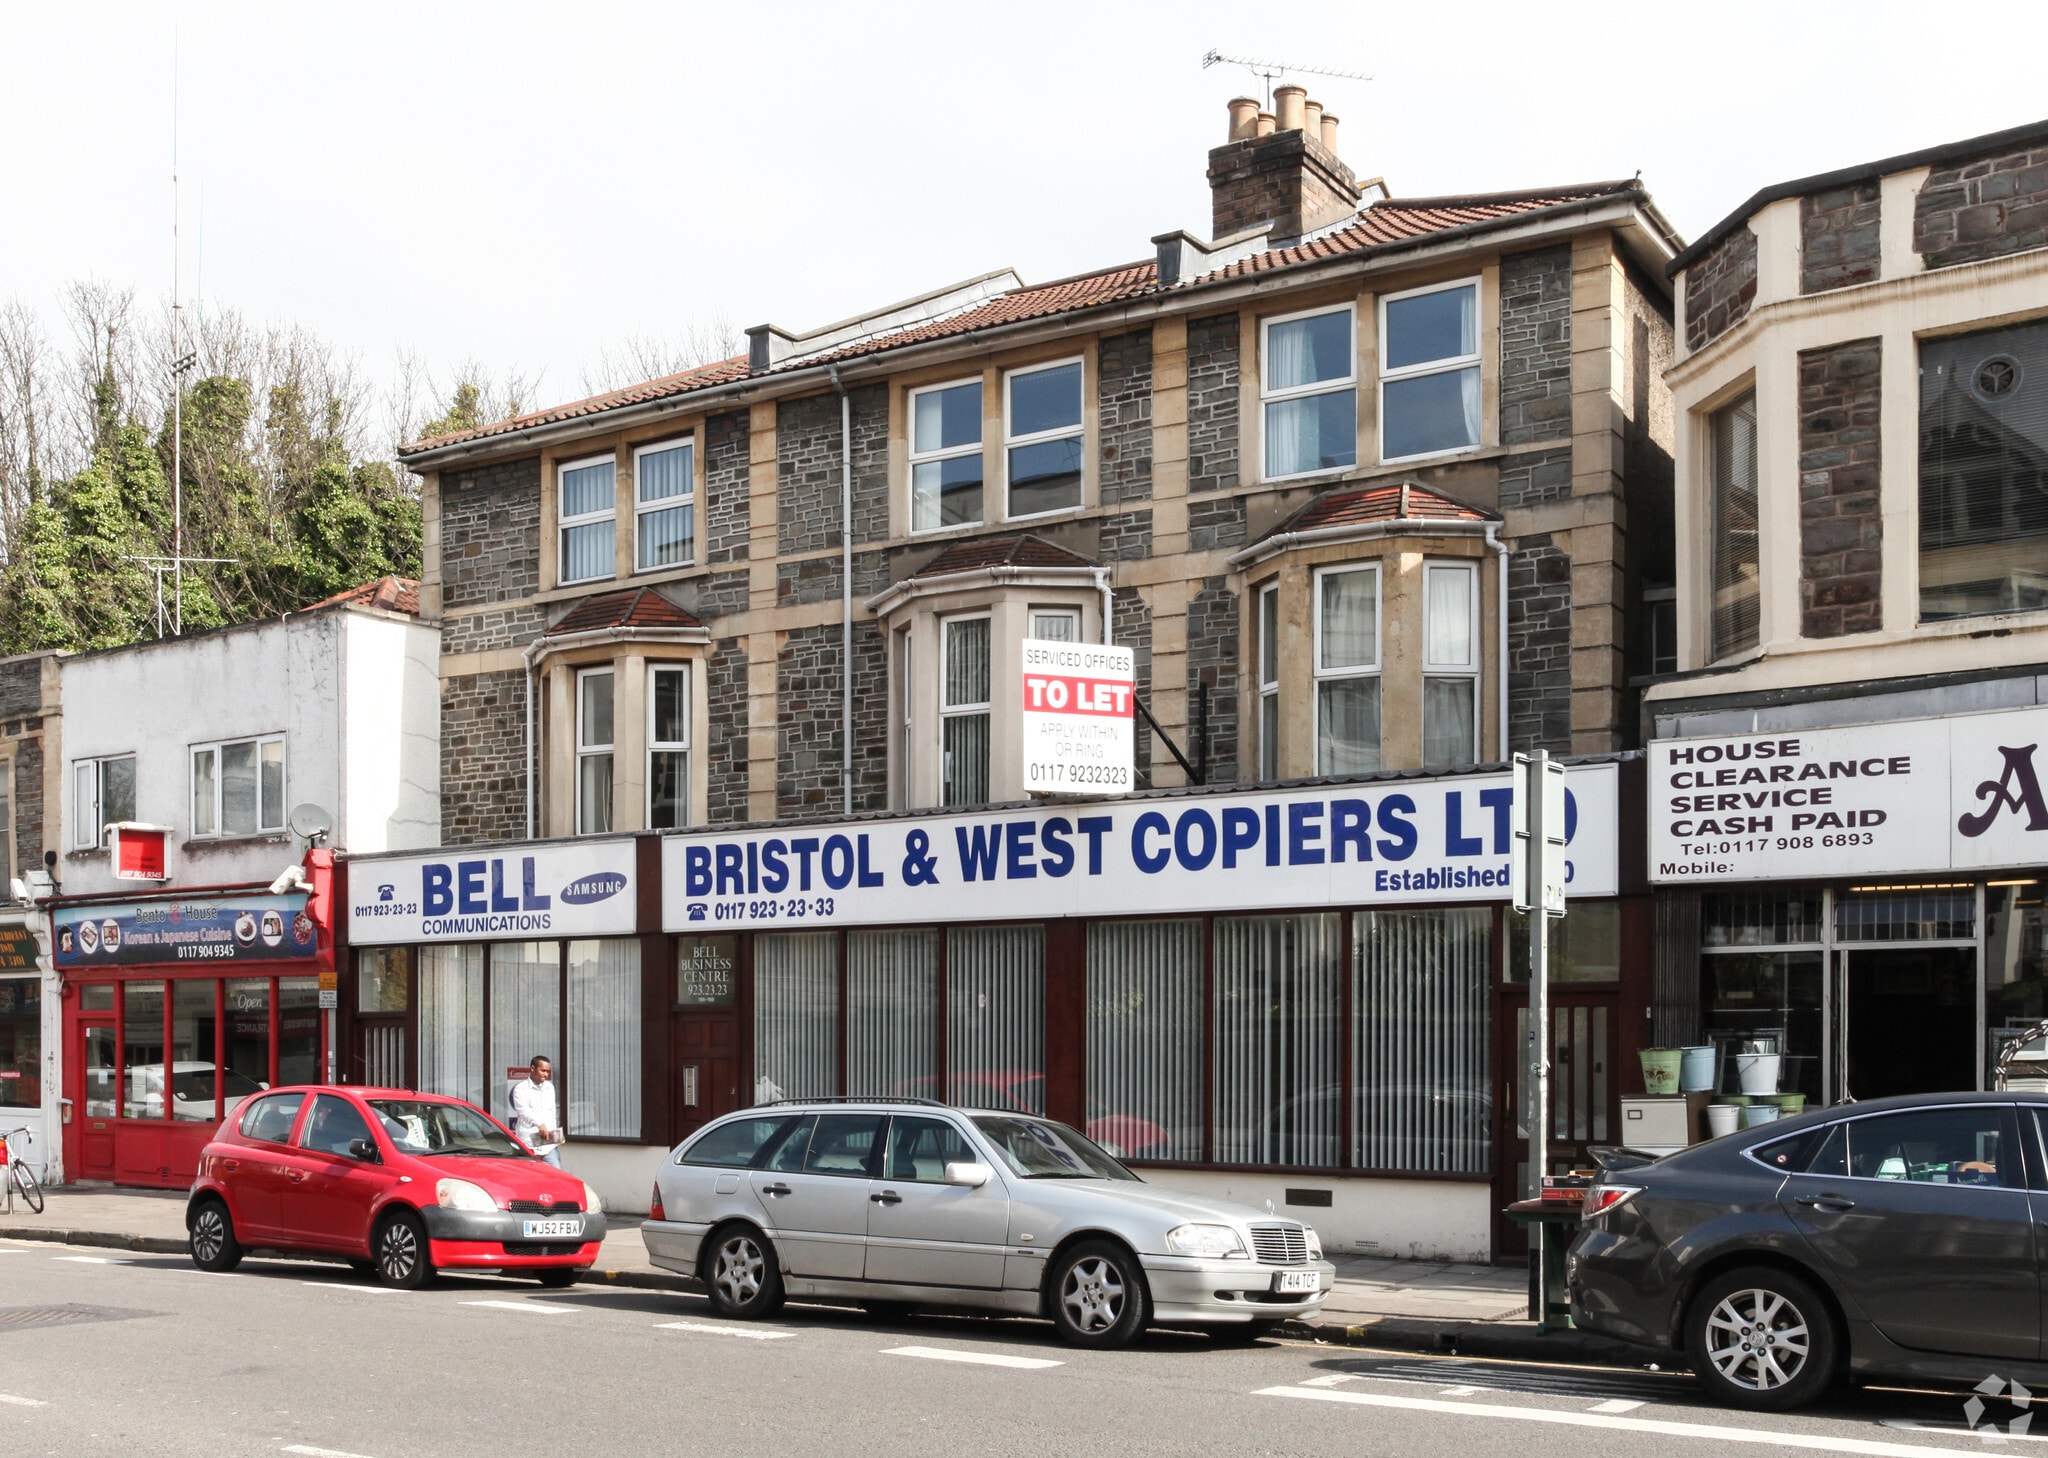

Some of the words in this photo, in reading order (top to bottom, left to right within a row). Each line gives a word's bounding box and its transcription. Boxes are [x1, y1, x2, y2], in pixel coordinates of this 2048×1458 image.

[1027, 649, 1081, 667] SERVICED
[1084, 654, 1130, 671] OFFICES
[1027, 678, 1069, 708] TO
[1077, 682, 1130, 712] LET
[1041, 722, 1075, 738] APPLY
[1078, 725, 1118, 741] WITHIN
[1055, 742, 1072, 757] OR
[1076, 743, 1104, 759] RING
[1669, 739, 1800, 765] HOUSE
[1030, 762, 1065, 782] 0117
[1069, 764, 1128, 785] 9232323
[1670, 756, 1911, 789] CLEARANCE
[1670, 787, 1832, 814] SERVICE
[1670, 815, 1773, 838] CASH
[1791, 809, 1888, 831] PAID
[685, 833, 883, 897] BRISTOL
[901, 828, 939, 886] &
[955, 815, 1114, 881] WEST
[1132, 794, 1418, 875] COPIERS
[1445, 786, 1577, 857] LT
[1681, 838, 1769, 856] Tel:0117
[1776, 836, 1814, 850] 908
[1822, 832, 1874, 848] 6893
[1375, 863, 1510, 892] Established
[1660, 861, 1734, 875] Mobile:
[422, 857, 551, 917] BELL
[566, 880, 622, 896] SAMSUNG
[136, 908, 166, 923] Bento
[185, 905, 217, 921] House
[355, 904, 373, 917] 0117
[715, 900, 746, 922] 0117
[422, 914, 551, 935] COMMUNICATIONS
[124, 931, 153, 945] Korean
[154, 933, 160, 943] &
[160, 929, 199, 947] Japanese
[200, 926, 232, 942] Cuisine
[177, 946, 196, 958] 0117
[198, 945, 213, 957] 904
[214, 944, 234, 957] 9345
[693, 946, 719, 958] BELL
[681, 958, 732, 970] BUSINESS
[683, 970, 729, 983] CENTRE
[687, 984, 728, 996] 923.23.23
[237, 994, 262, 1011] Open
[531, 1222, 557, 1235] WJ52
[559, 1222, 578, 1235] FBX
